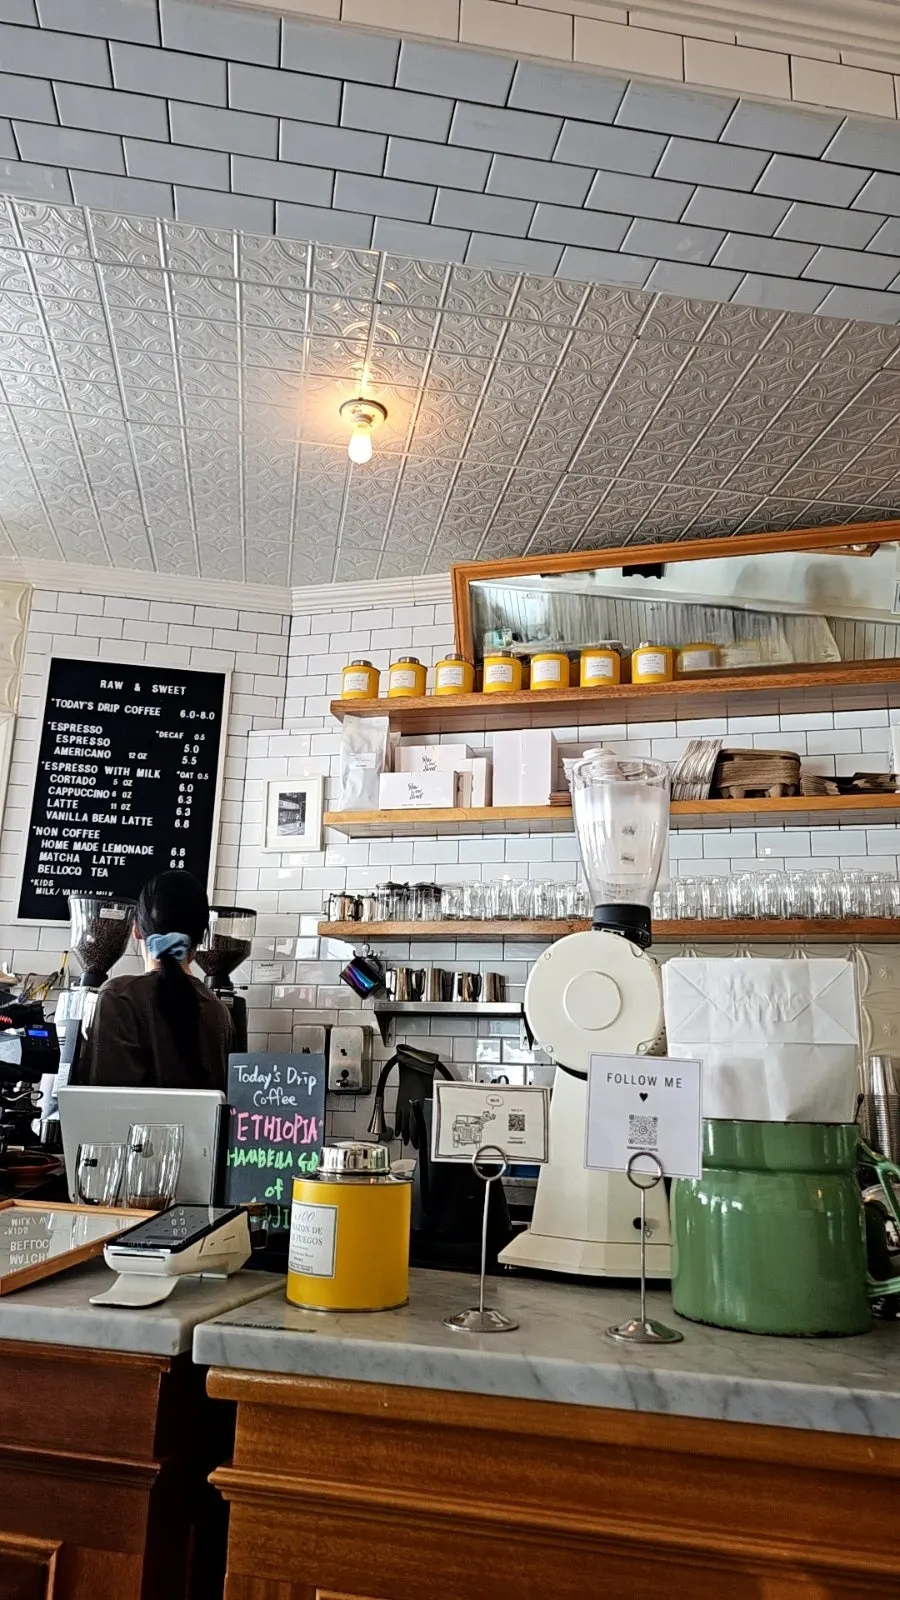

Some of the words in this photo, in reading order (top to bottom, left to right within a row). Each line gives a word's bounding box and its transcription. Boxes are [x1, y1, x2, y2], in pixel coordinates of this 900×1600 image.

[100, 680, 124, 690] RAW
[134, 682, 141, 692] &
[152, 684, 187, 695] SWEET
[98, 702, 120, 713] DRIP
[124, 705, 161, 716] COFFEE
[180, 710, 216, 720] 6.0-8.0
[56, 734, 111, 747] ESPRESSO
[184, 744, 200, 754] 5.0
[54, 746, 112, 759] AMERICANO
[182, 756, 197, 765] 5.5
[104, 766, 130, 777] WITH
[136, 768, 161, 779] MILK
[50, 774, 96, 786] CORTADO
[123, 779, 133, 787] OZ
[179, 783, 194, 793] 6.0
[48, 786, 110, 799] CAPPUCCINO
[178, 795, 193, 805] 6.3
[47, 798, 79, 809] LATTE
[121, 803, 131, 811] OZ
[176, 807, 191, 817] 6.3
[46, 811, 89, 823] VANILLA
[92, 814, 118, 824] BEAN
[122, 816, 153, 827] LATTE
[174, 819, 190, 829] 6.8
[62, 828, 101, 839] COFFEE
[41, 839, 69, 850] HOME
[73, 842, 99, 852] MADE
[102, 843, 154, 855] LEMONADE
[171, 848, 186, 857] 6.8
[39, 852, 80, 863] MATCHA
[92, 855, 126, 866] LATTE
[170, 860, 185, 869] 6.8
[38, 864, 82, 876] BELLOCQ
[91, 867, 109, 878] TEA
[233, 1064, 281, 1091] Today's
[286, 1066, 317, 1096] Drip
[606, 1073, 657, 1086] FOLLOW
[665, 1077, 683, 1089] ME
[253, 1086, 298, 1107] Coffee
[264, 1178, 285, 1201] of
